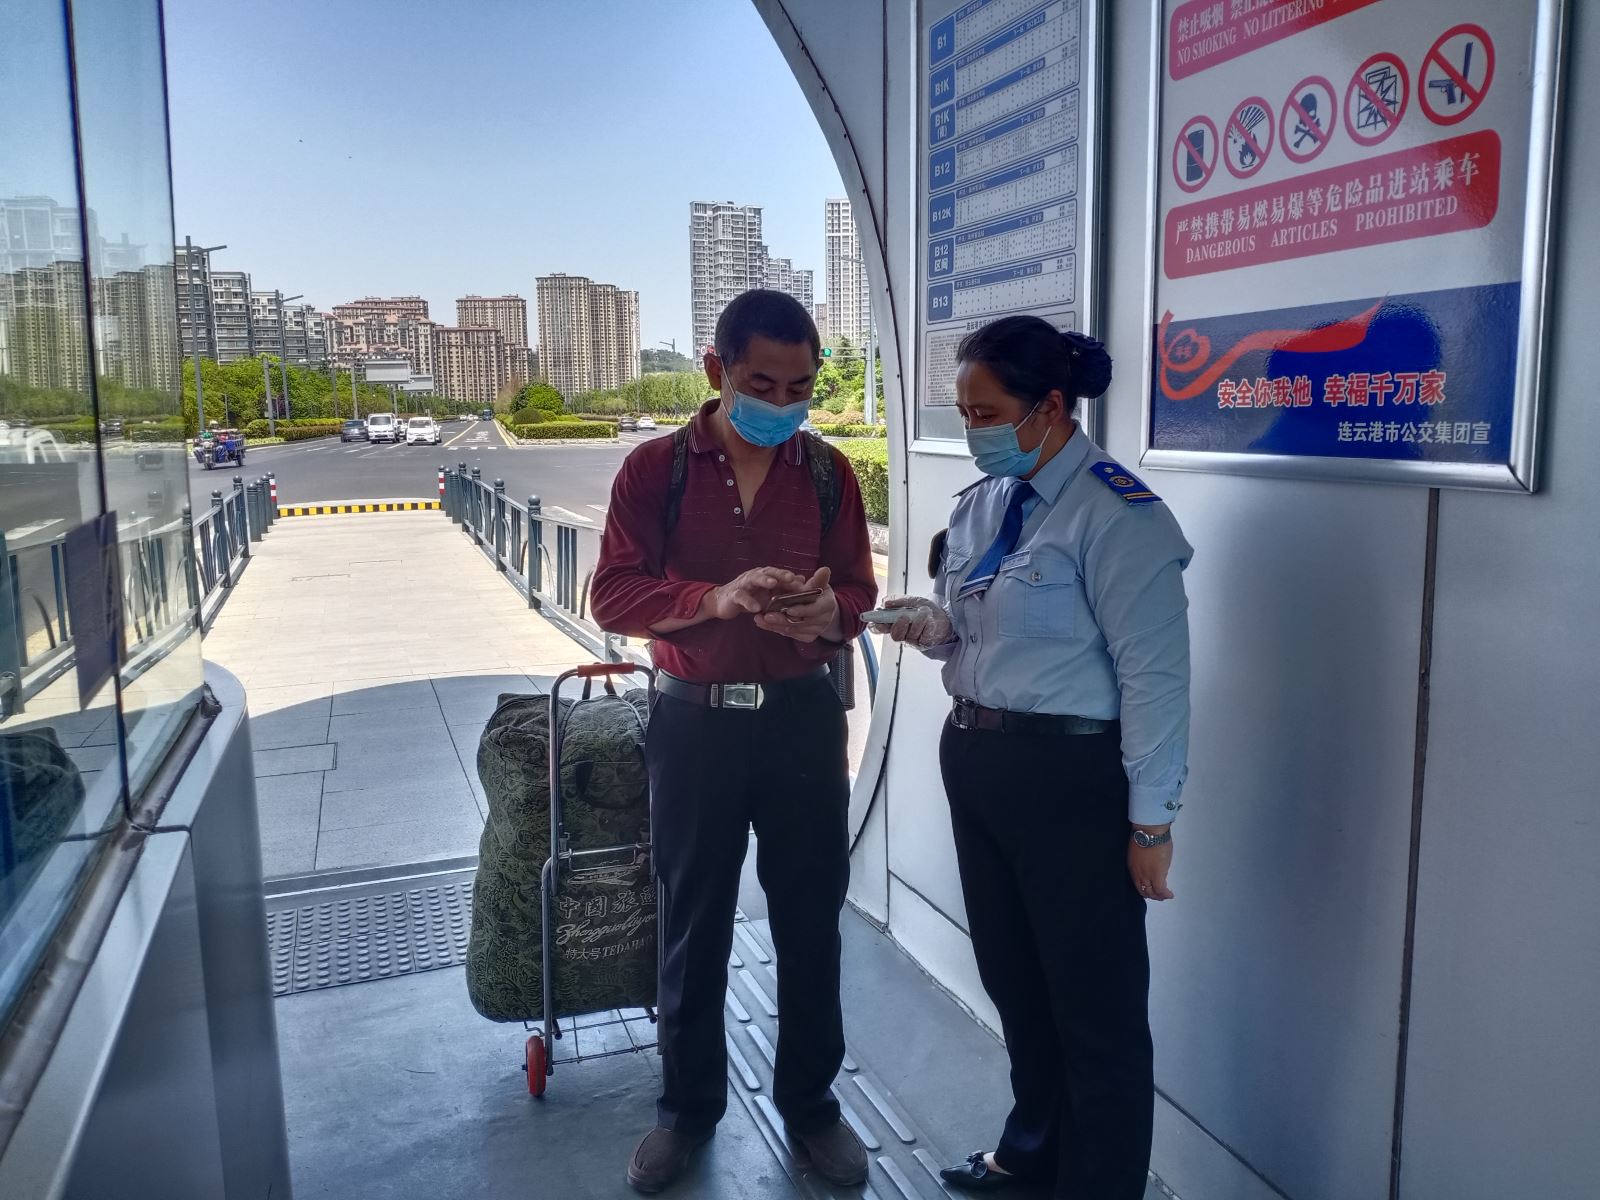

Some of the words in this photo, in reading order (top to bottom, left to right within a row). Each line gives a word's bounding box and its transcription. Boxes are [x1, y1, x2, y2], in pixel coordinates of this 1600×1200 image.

[1177, 2, 1225, 43] 禁止吸烟
[937, 33, 948, 50] B1
[1177, 47, 1191, 67] NO
[1192, 27, 1238, 61] SMOKING
[1243, 18, 1260, 40] NO
[1261, 0, 1325, 33] LITTERING
[935, 77, 950, 97] B1K
[935, 108, 950, 128] B1K
[935, 161, 950, 178] B12
[1176, 152, 1481, 245] 严禁携带易燃易爆等危险品进站乘车
[932, 206, 952, 222] B12K
[1186, 235, 1256, 264] DANGEROUS
[1271, 218, 1339, 248] ARTICLES
[1355, 195, 1459, 232] PROHIBITED
[934, 243, 949, 257] B12
[932, 295, 949, 309] B13
[1217, 376, 1313, 409] 安全你我他
[1323, 369, 1447, 407] 幸福千万家
[1337, 420, 1492, 445] 连云港市公交集团宣
